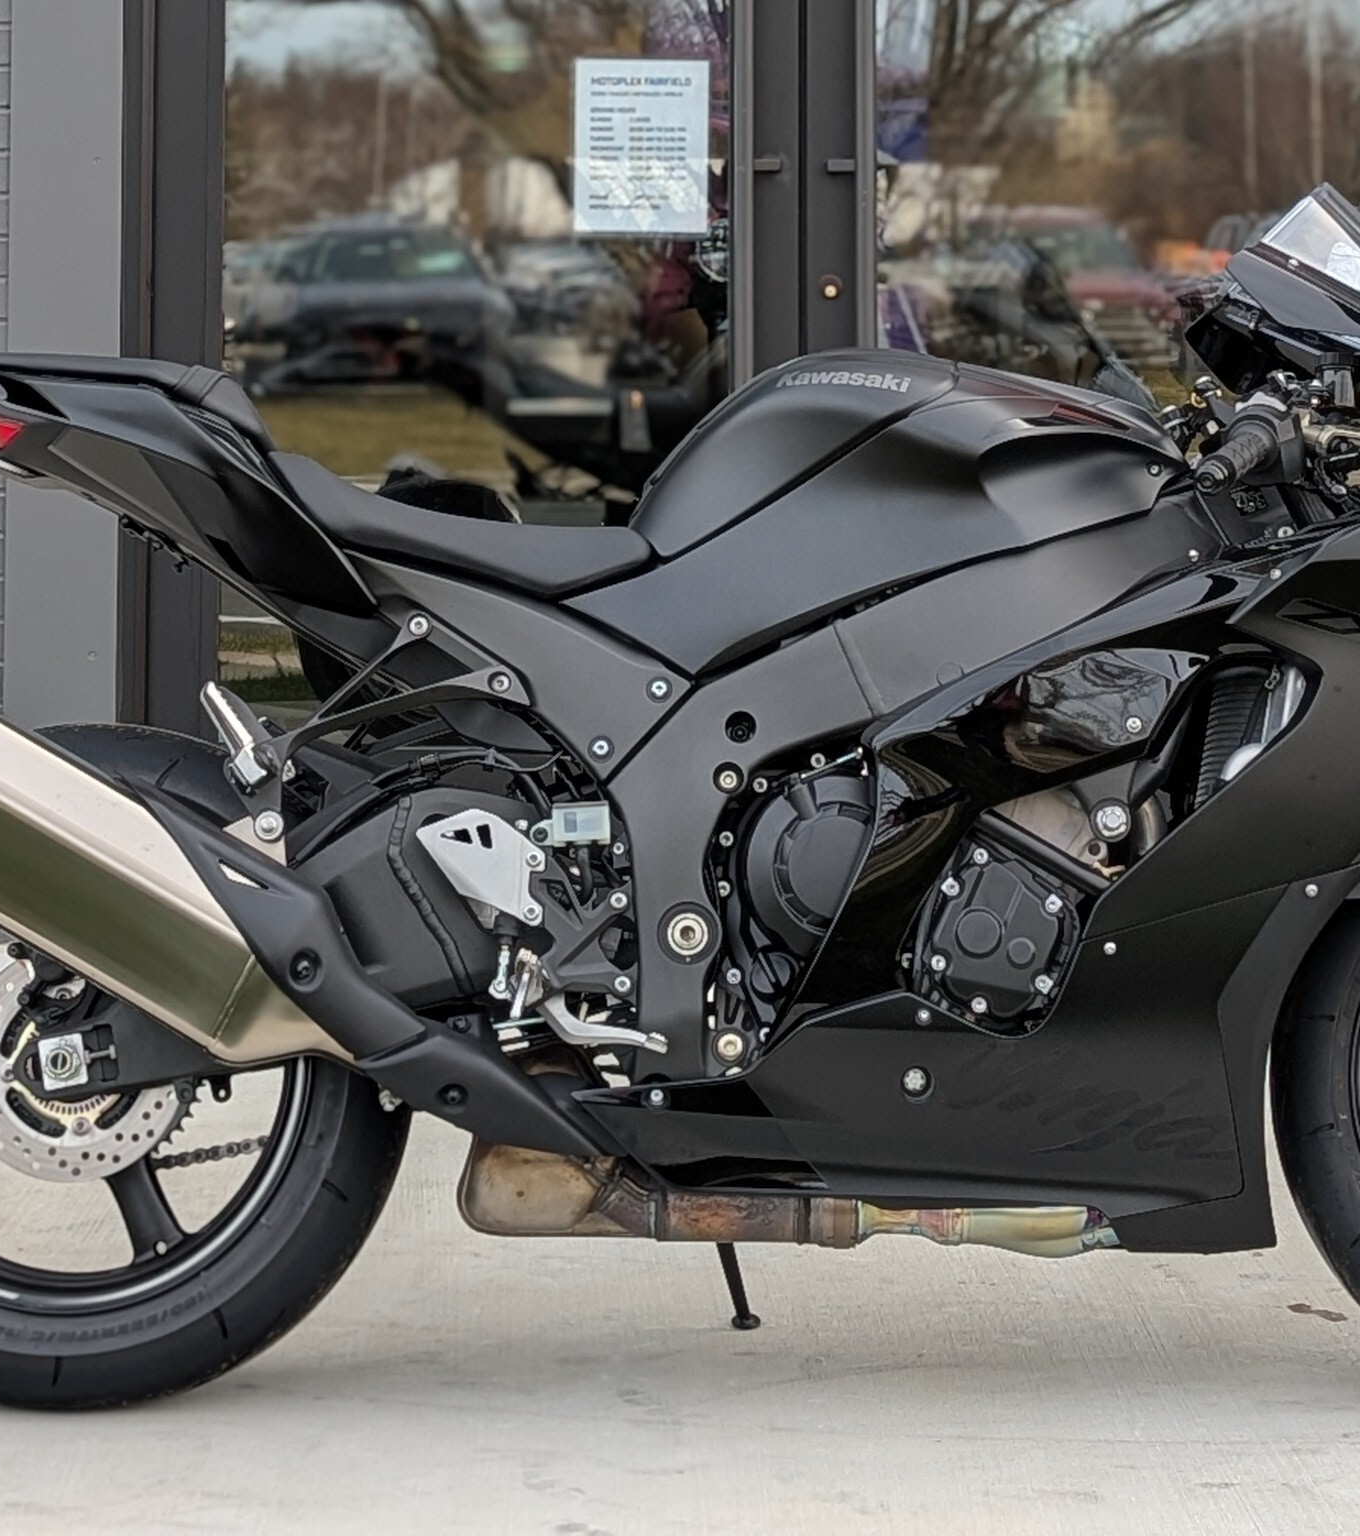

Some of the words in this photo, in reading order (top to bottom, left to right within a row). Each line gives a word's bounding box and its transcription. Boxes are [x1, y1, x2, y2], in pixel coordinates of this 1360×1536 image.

[591, 76, 641, 86] MOTOPLEX
[644, 76, 692, 87] FAIRFIELD
[776, 370, 912, 393] Kawasaki
